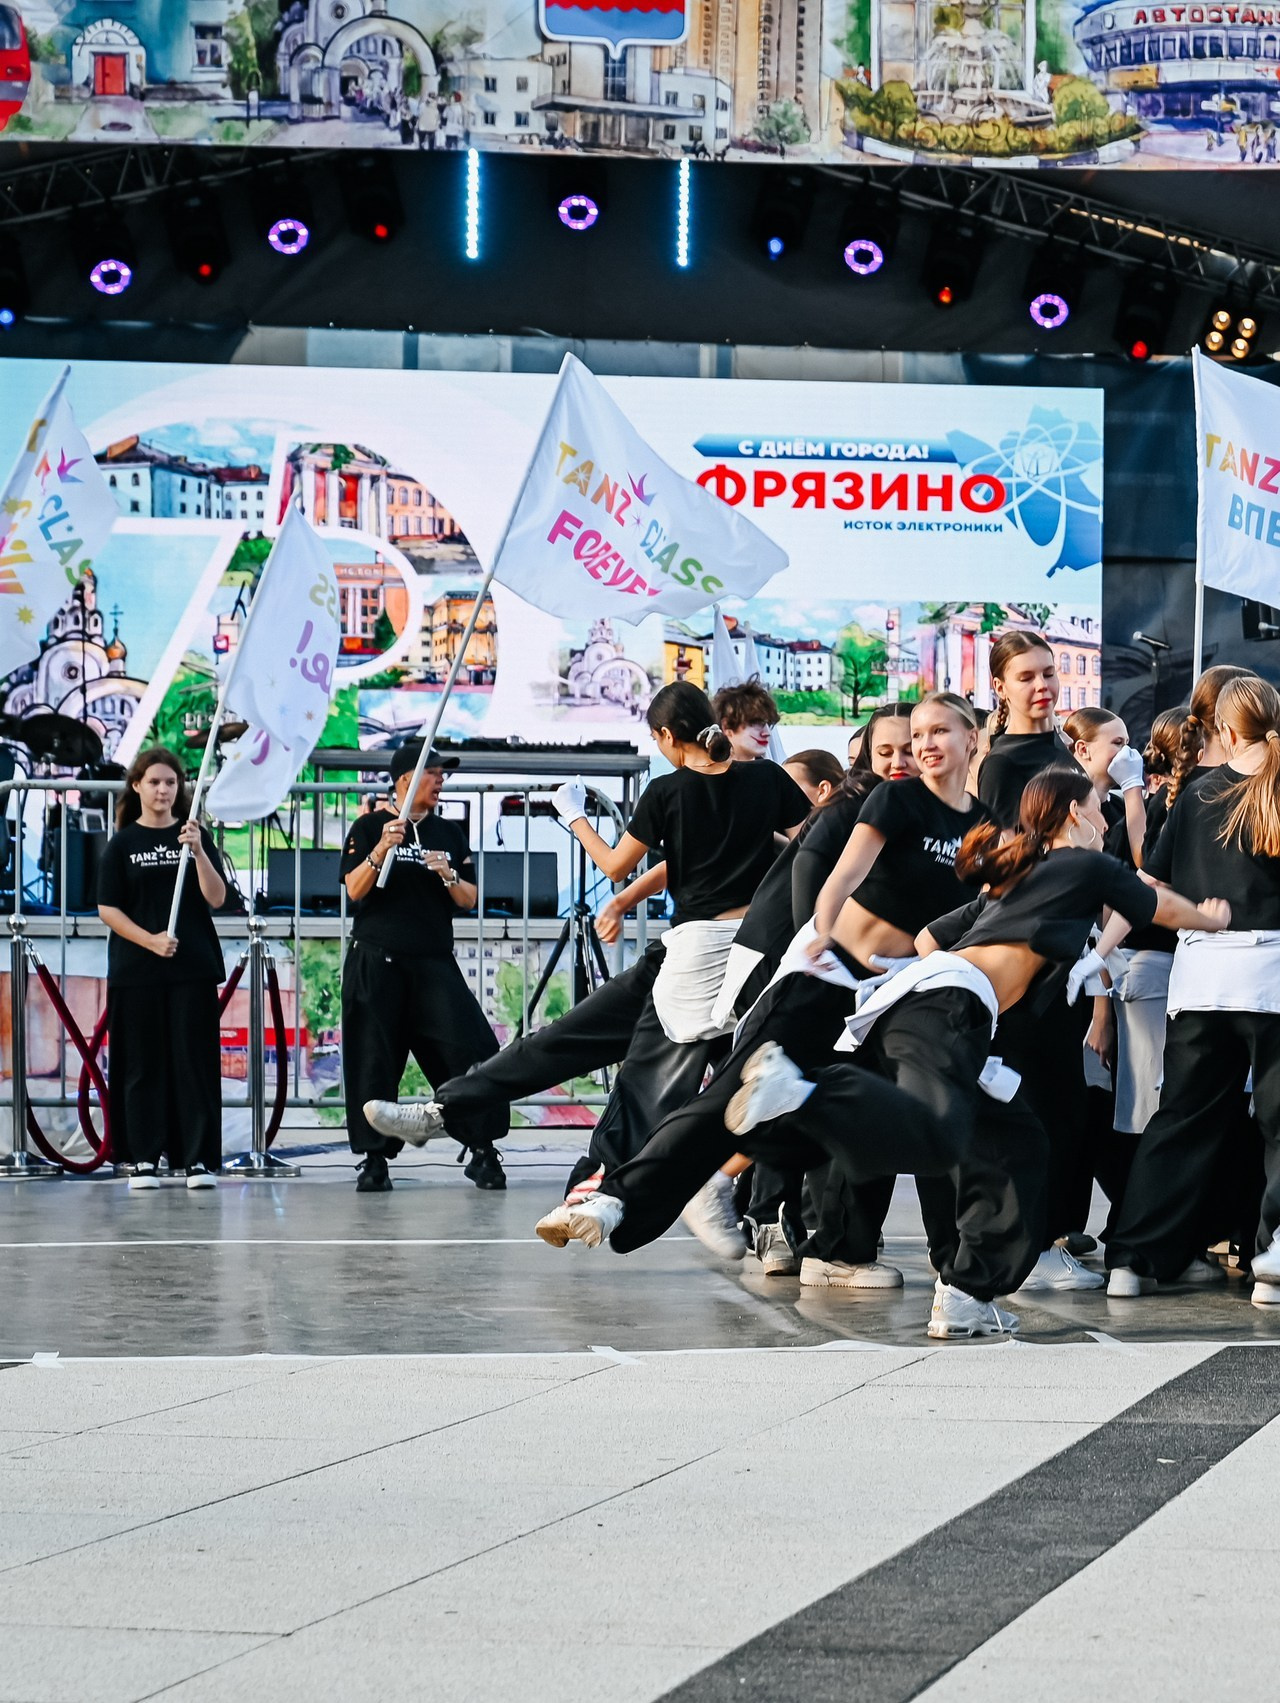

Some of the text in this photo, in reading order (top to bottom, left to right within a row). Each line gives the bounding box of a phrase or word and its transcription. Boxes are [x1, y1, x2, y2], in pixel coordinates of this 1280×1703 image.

[738, 438, 930, 461] С ДНЁМ ГОРОДА!
[556, 440, 632, 527] TANZ
[696, 464, 1007, 513] ФРЯЗИНО
[843, 520, 1003, 533] ИСТОК ЭЛЕКТРОНИКИ
[129, 851, 158, 865] TANZ
